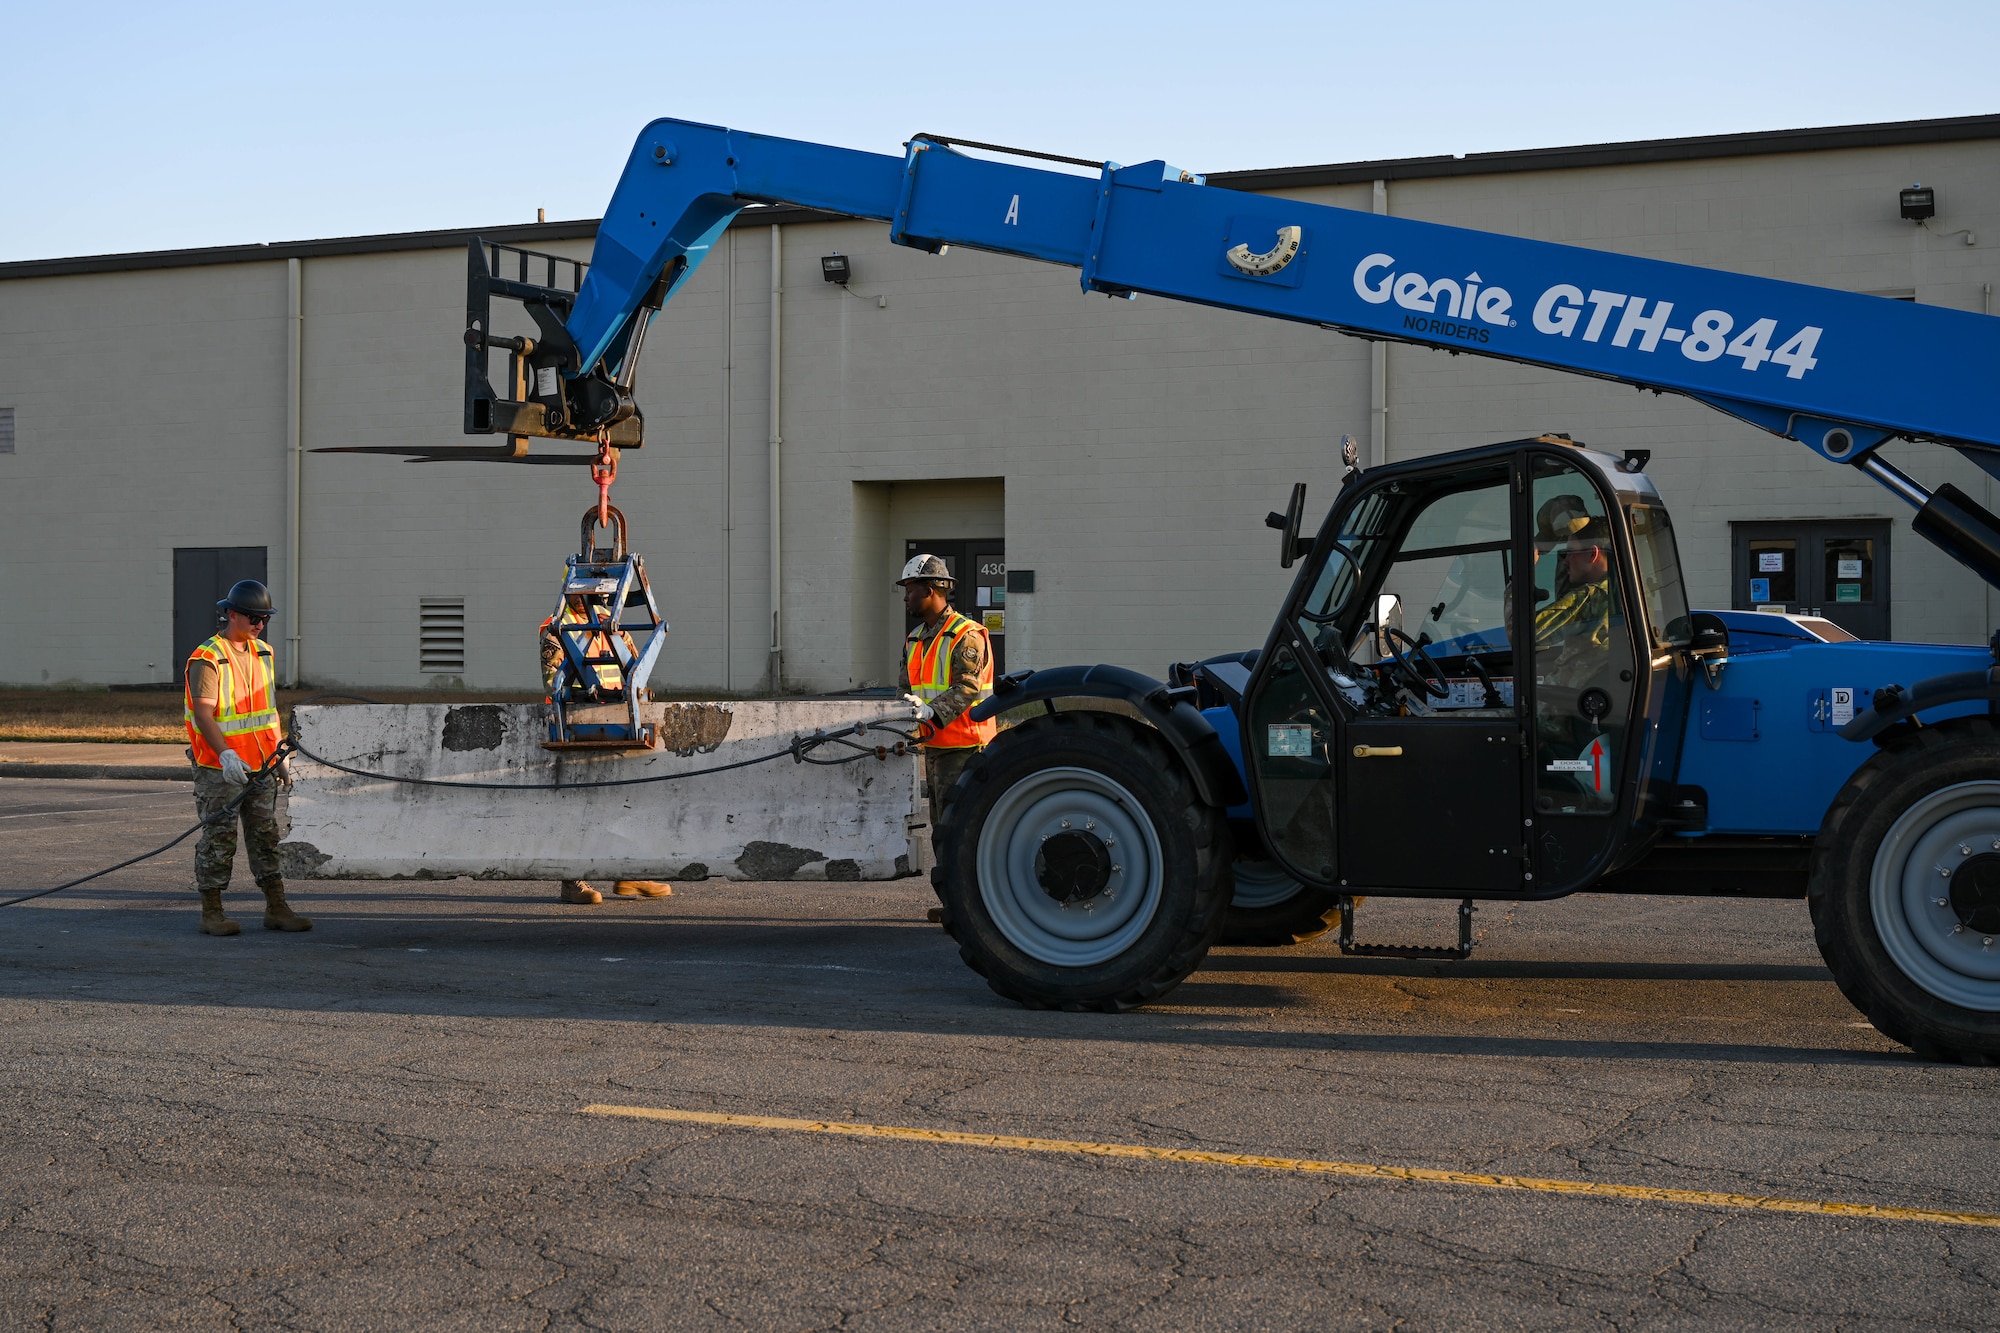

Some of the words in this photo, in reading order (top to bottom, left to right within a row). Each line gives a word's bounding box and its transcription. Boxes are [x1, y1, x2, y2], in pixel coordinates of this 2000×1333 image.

[1004, 194, 1019, 226] A
[1272, 263, 1282, 272] 40
[1282, 253, 1292, 264] 60
[1290, 241, 1298, 251] 80
[1353, 252, 1513, 327] Genie
[1403, 315, 1429, 332] NO
[1429, 319, 1490, 344] RIDERS
[1532, 284, 1824, 380] GTH-844
[1835, 691, 1850, 704] D
